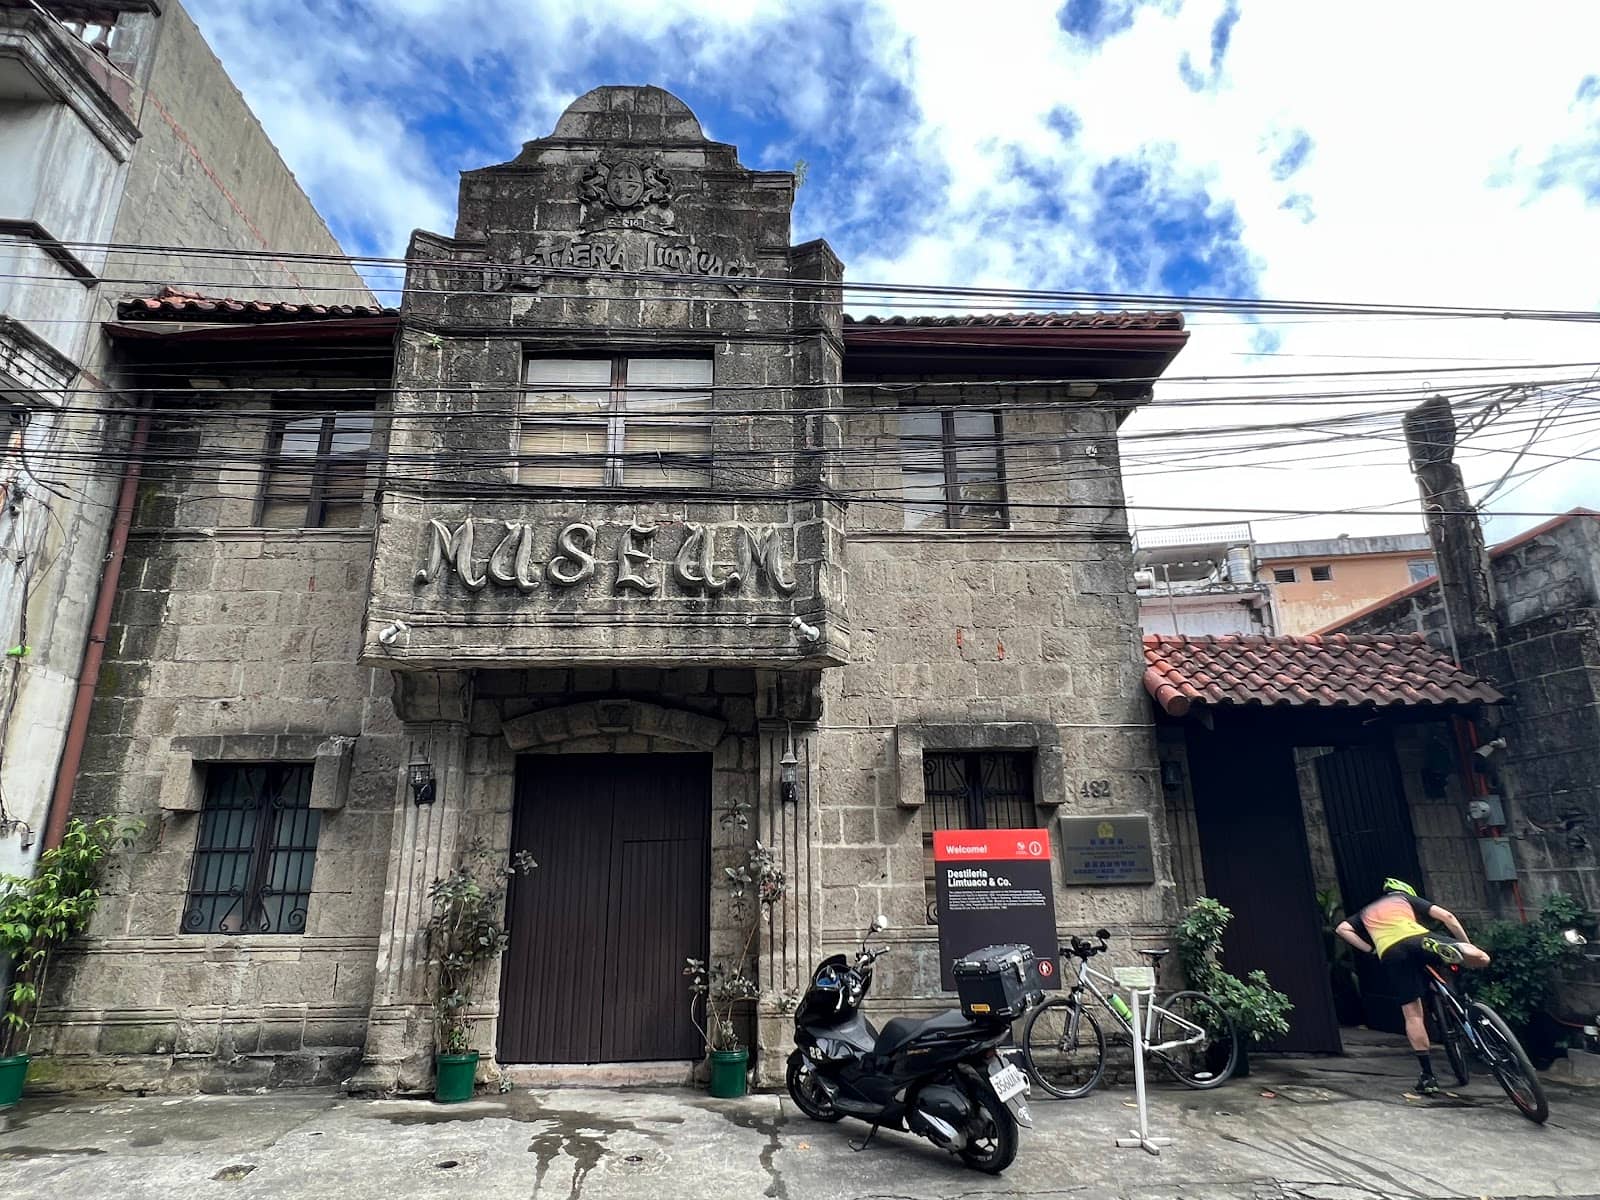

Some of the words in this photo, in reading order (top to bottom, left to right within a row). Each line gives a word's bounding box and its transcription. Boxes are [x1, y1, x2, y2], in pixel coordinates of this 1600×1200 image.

[415, 518, 797, 595] MUSEUM
[1080, 780, 1110, 798] 482
[945, 844, 987, 854] Welcome!
[947, 869, 988, 879] Destileria
[948, 878, 987, 887] Limtuaco
[989, 878, 995, 887] &
[997, 877, 1012, 887] Co.
